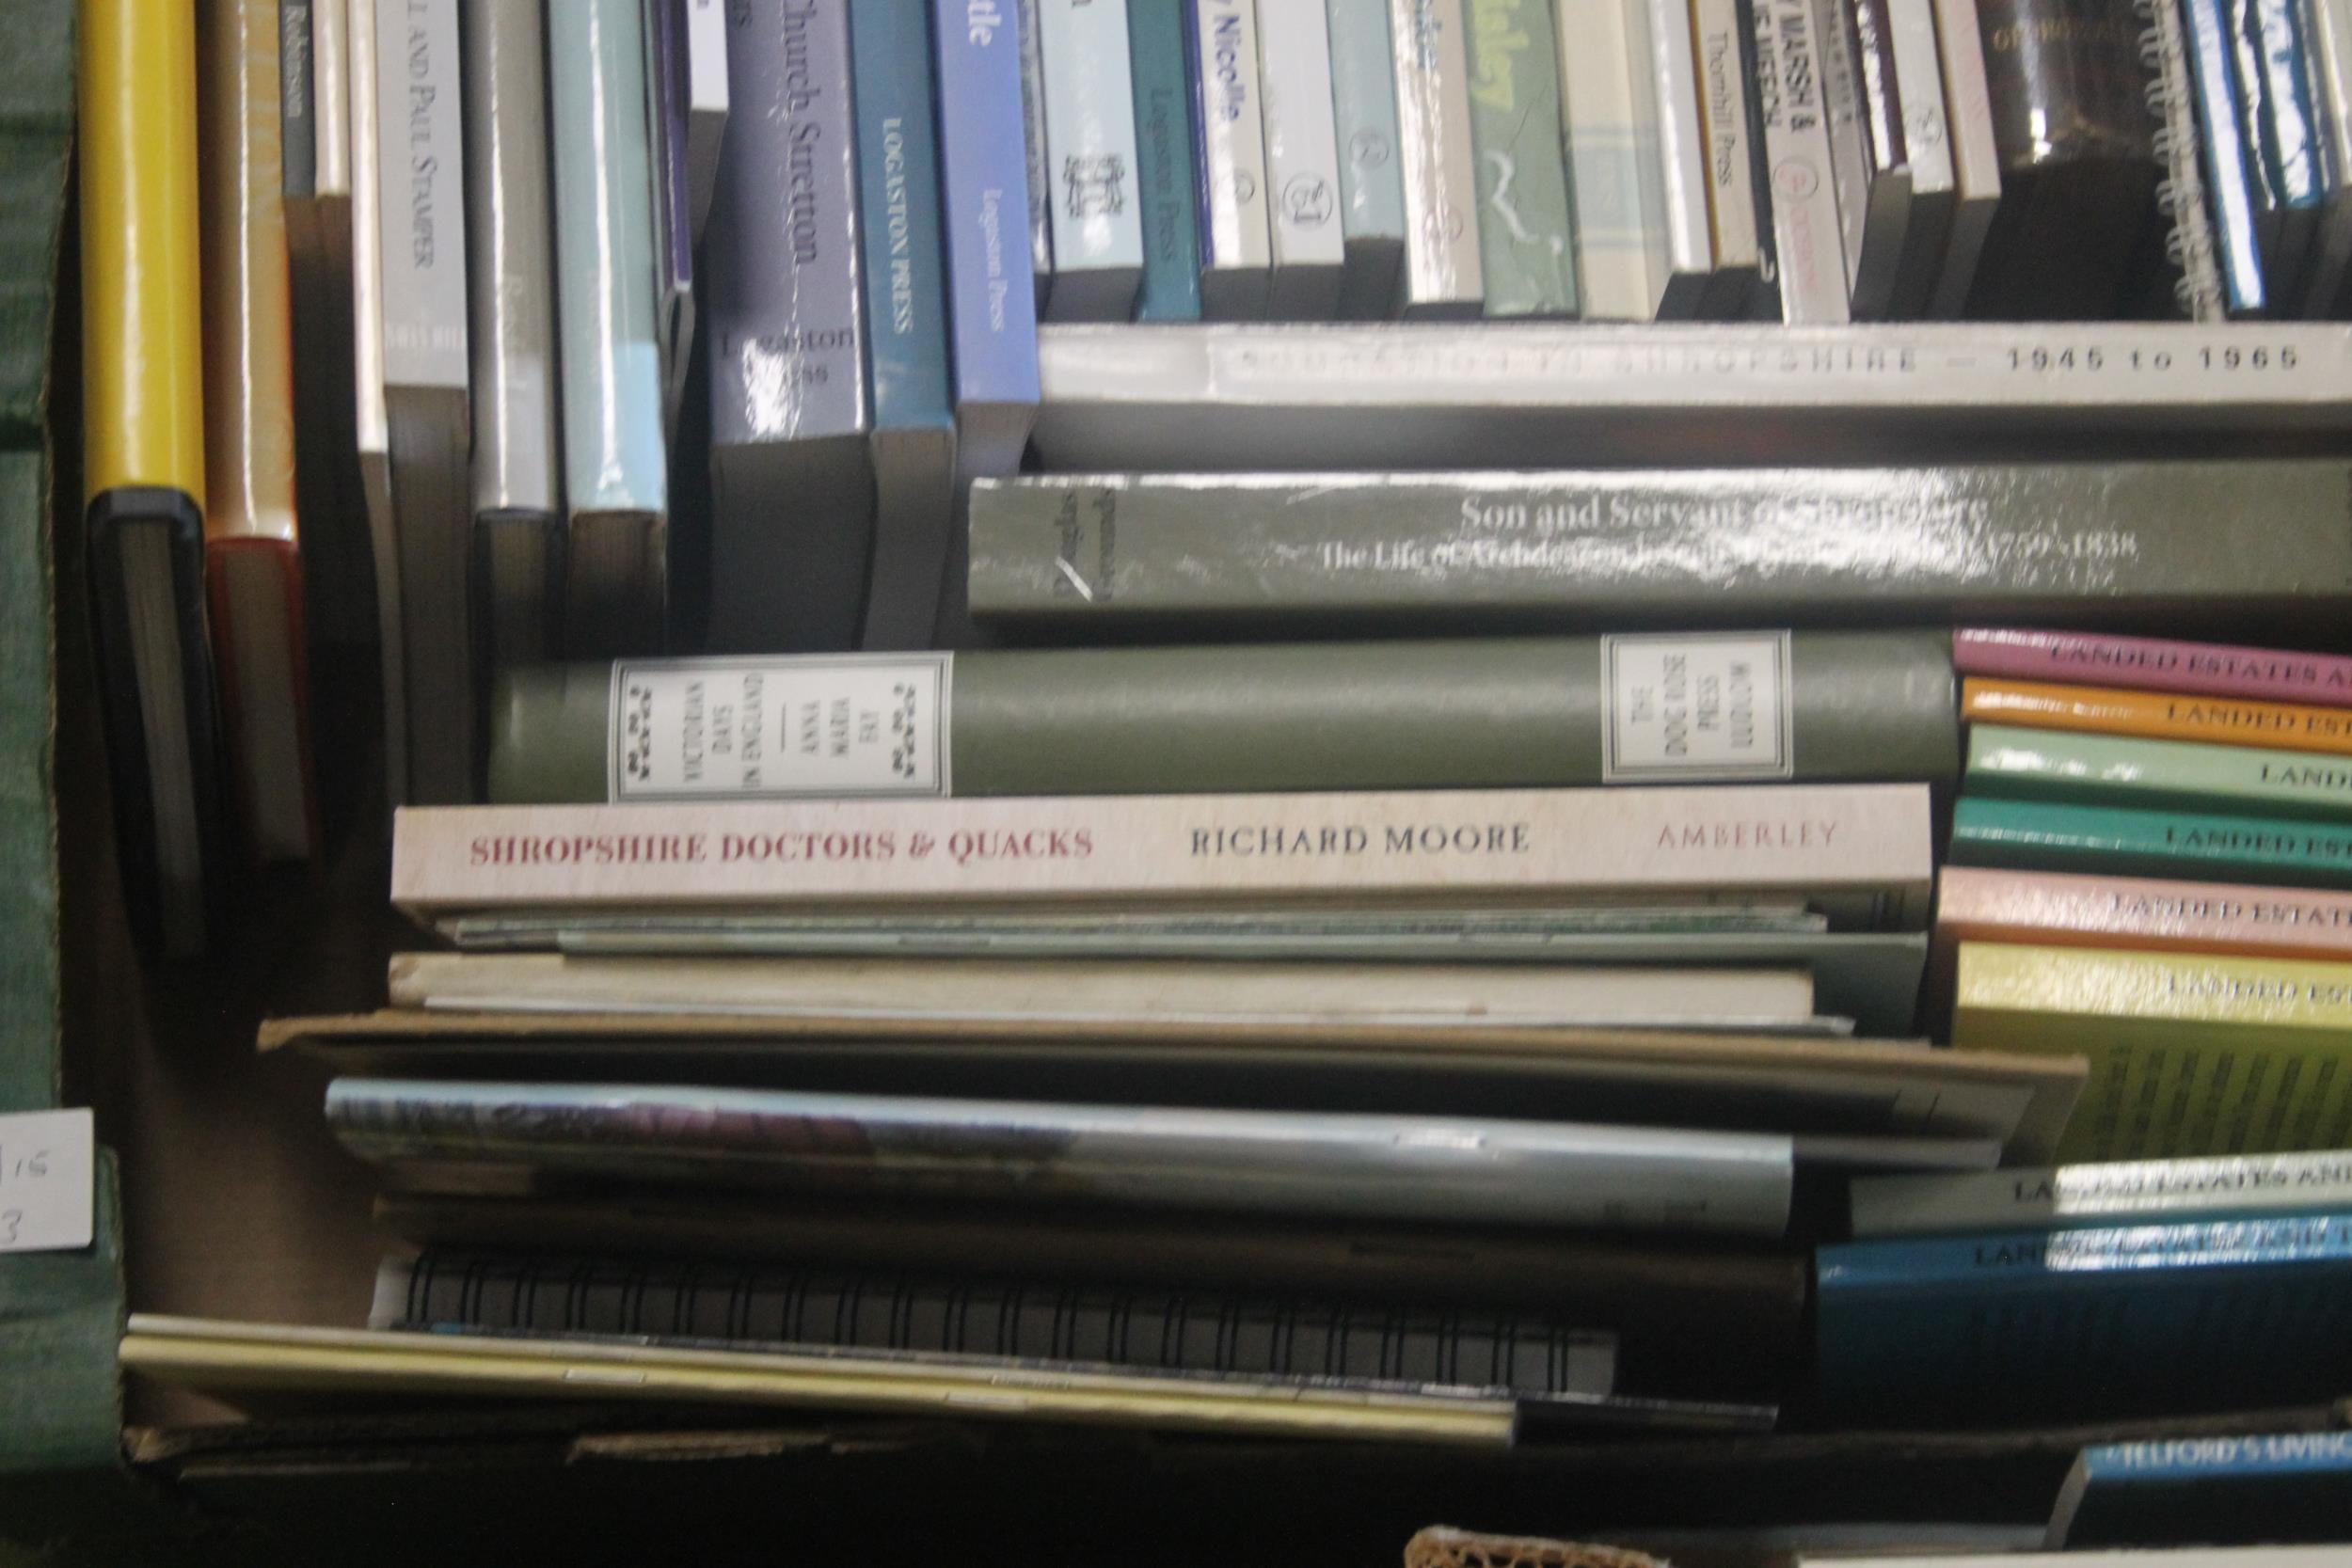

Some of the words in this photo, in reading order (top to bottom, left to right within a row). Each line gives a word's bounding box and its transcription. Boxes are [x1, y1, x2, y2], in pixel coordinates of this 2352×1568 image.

[787, 121, 821, 264] Stretton
[882, 118, 911, 256] LOGASTON
[890, 259, 914, 334] PRESS
[2006, 345, 2104, 372] 1945
[2129, 348, 2172, 372] to
[2197, 345, 2298, 372] 1965
[1461, 495, 1527, 529] Son
[1535, 495, 1600, 531] and
[1324, 541, 1369, 569] The
[1375, 540, 1426, 569] Life
[2049, 642, 2180, 673] LANDED
[2186, 654, 2317, 683] ESTATES
[2328, 667, 2352, 686] A
[2167, 702, 2296, 730] LANDED
[470, 833, 707, 866] SHROPSHIRE
[721, 832, 897, 863] DOCTORS
[909, 832, 936, 857] &
[946, 829, 1094, 865] QUACKS
[1189, 826, 1368, 856] RICHARD
[1384, 823, 1532, 855] MOORE
[1657, 821, 1838, 850] AMBERLEY
[2166, 825, 2296, 853] LANDED
[2110, 895, 2242, 921] LANDED
